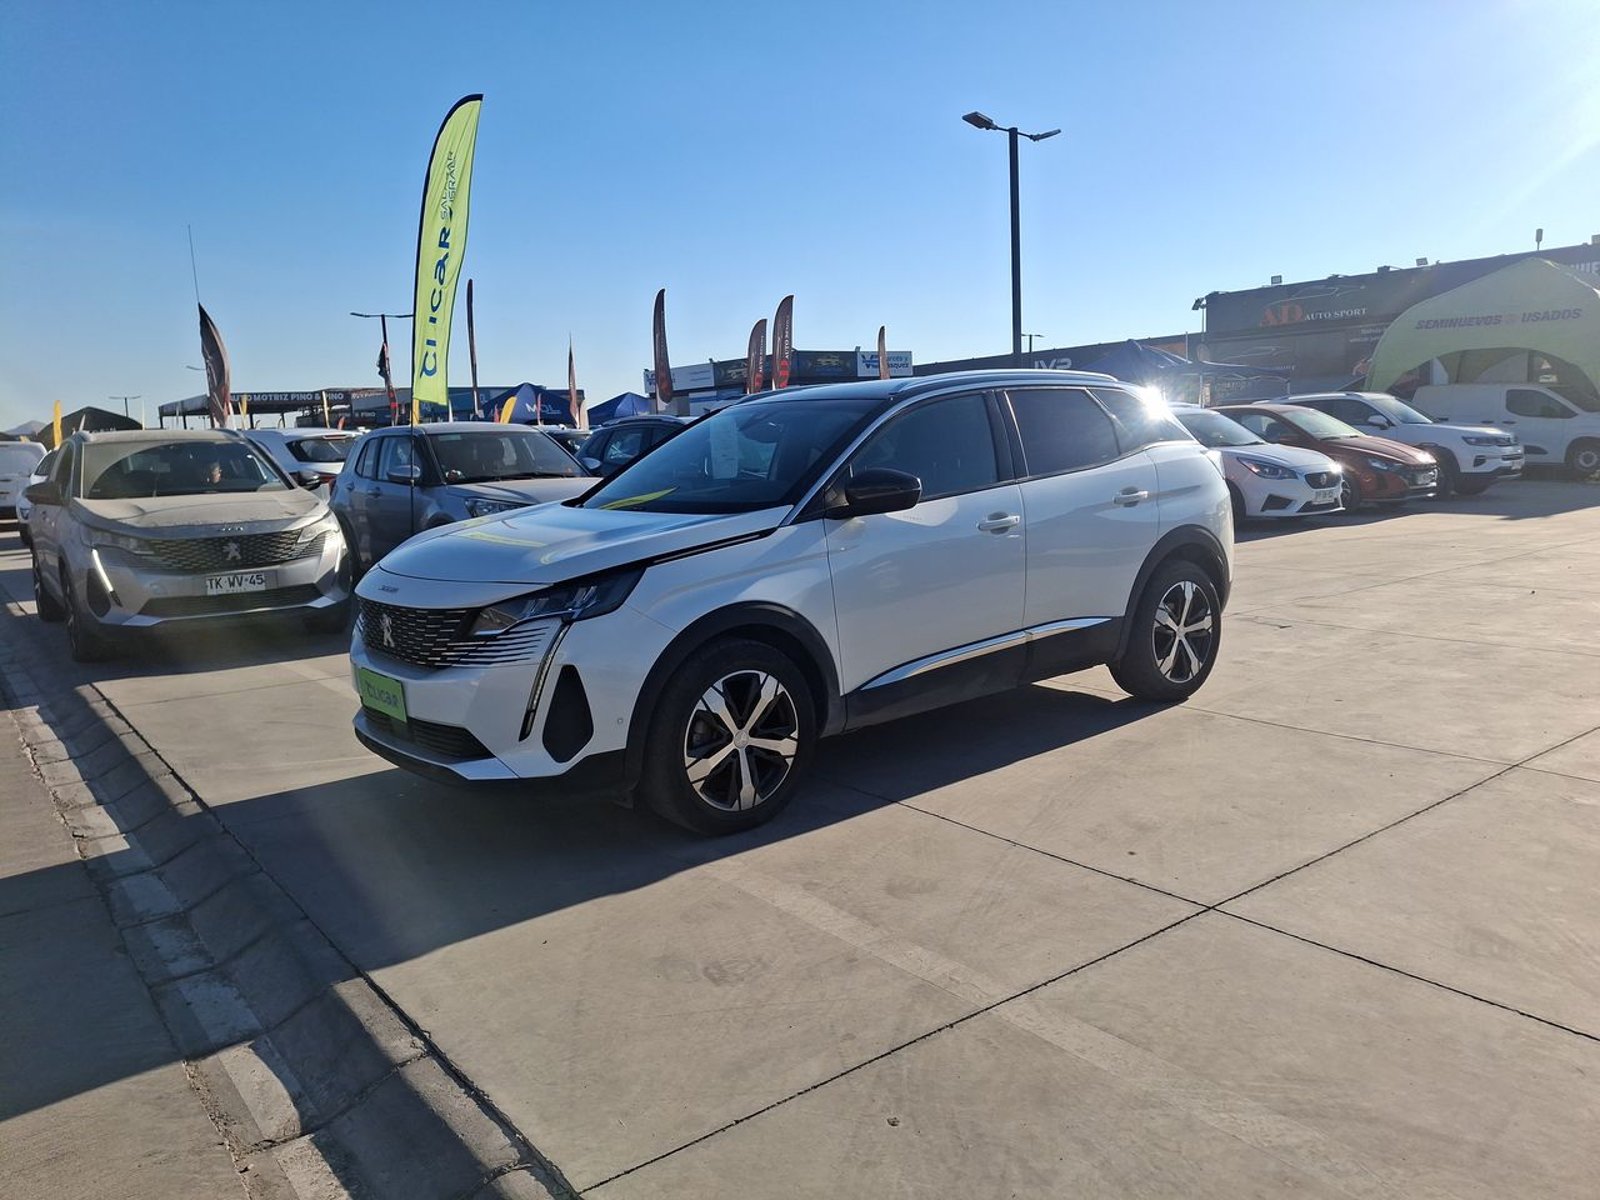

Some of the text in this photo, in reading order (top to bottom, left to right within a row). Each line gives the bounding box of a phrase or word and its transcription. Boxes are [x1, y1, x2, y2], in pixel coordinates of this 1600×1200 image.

[1304, 312, 1331, 321] AUTO
[1334, 307, 1367, 319] SPORT
[1415, 315, 1503, 331] SEMINUEVOS
[1521, 308, 1583, 324] USADOS
[291, 393, 313, 401] PINO
